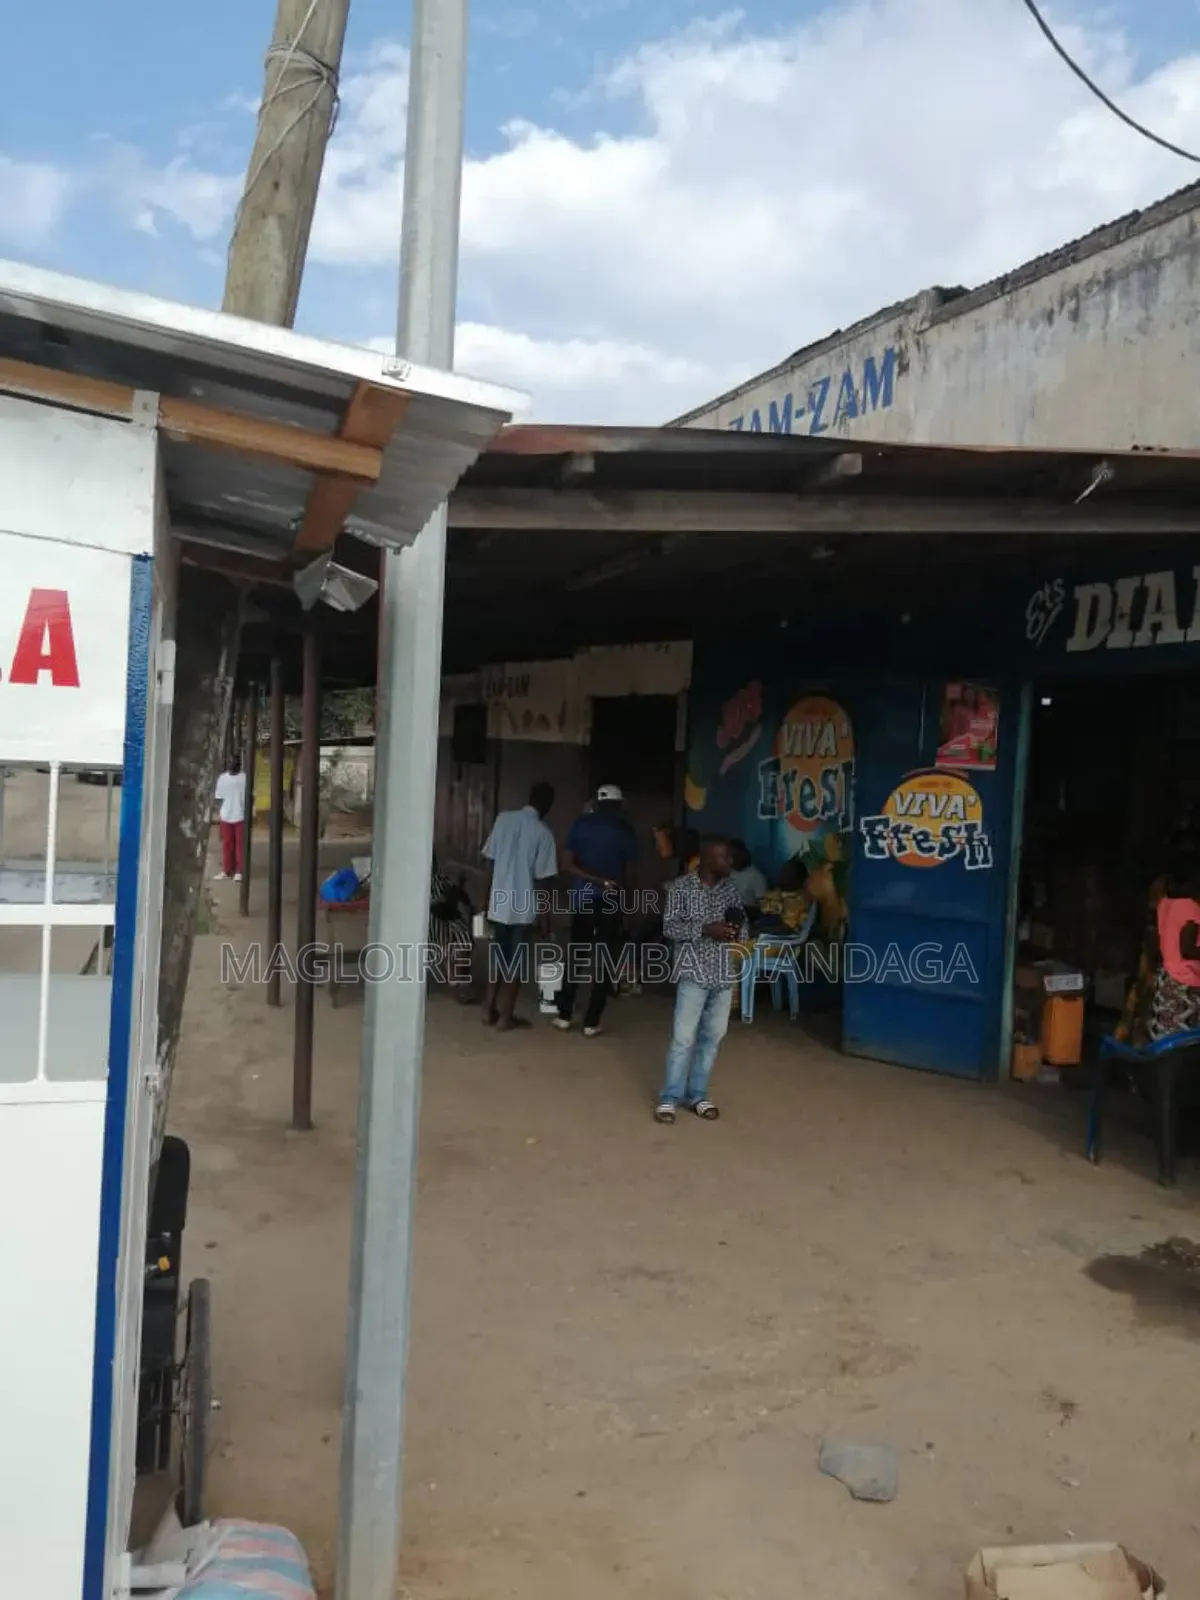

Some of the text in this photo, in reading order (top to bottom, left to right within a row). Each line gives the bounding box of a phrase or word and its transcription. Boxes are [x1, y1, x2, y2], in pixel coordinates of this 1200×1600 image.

[781, 722, 840, 758] VIVA
[893, 791, 967, 820] VIVA
[859, 814, 993, 871] Fresh
